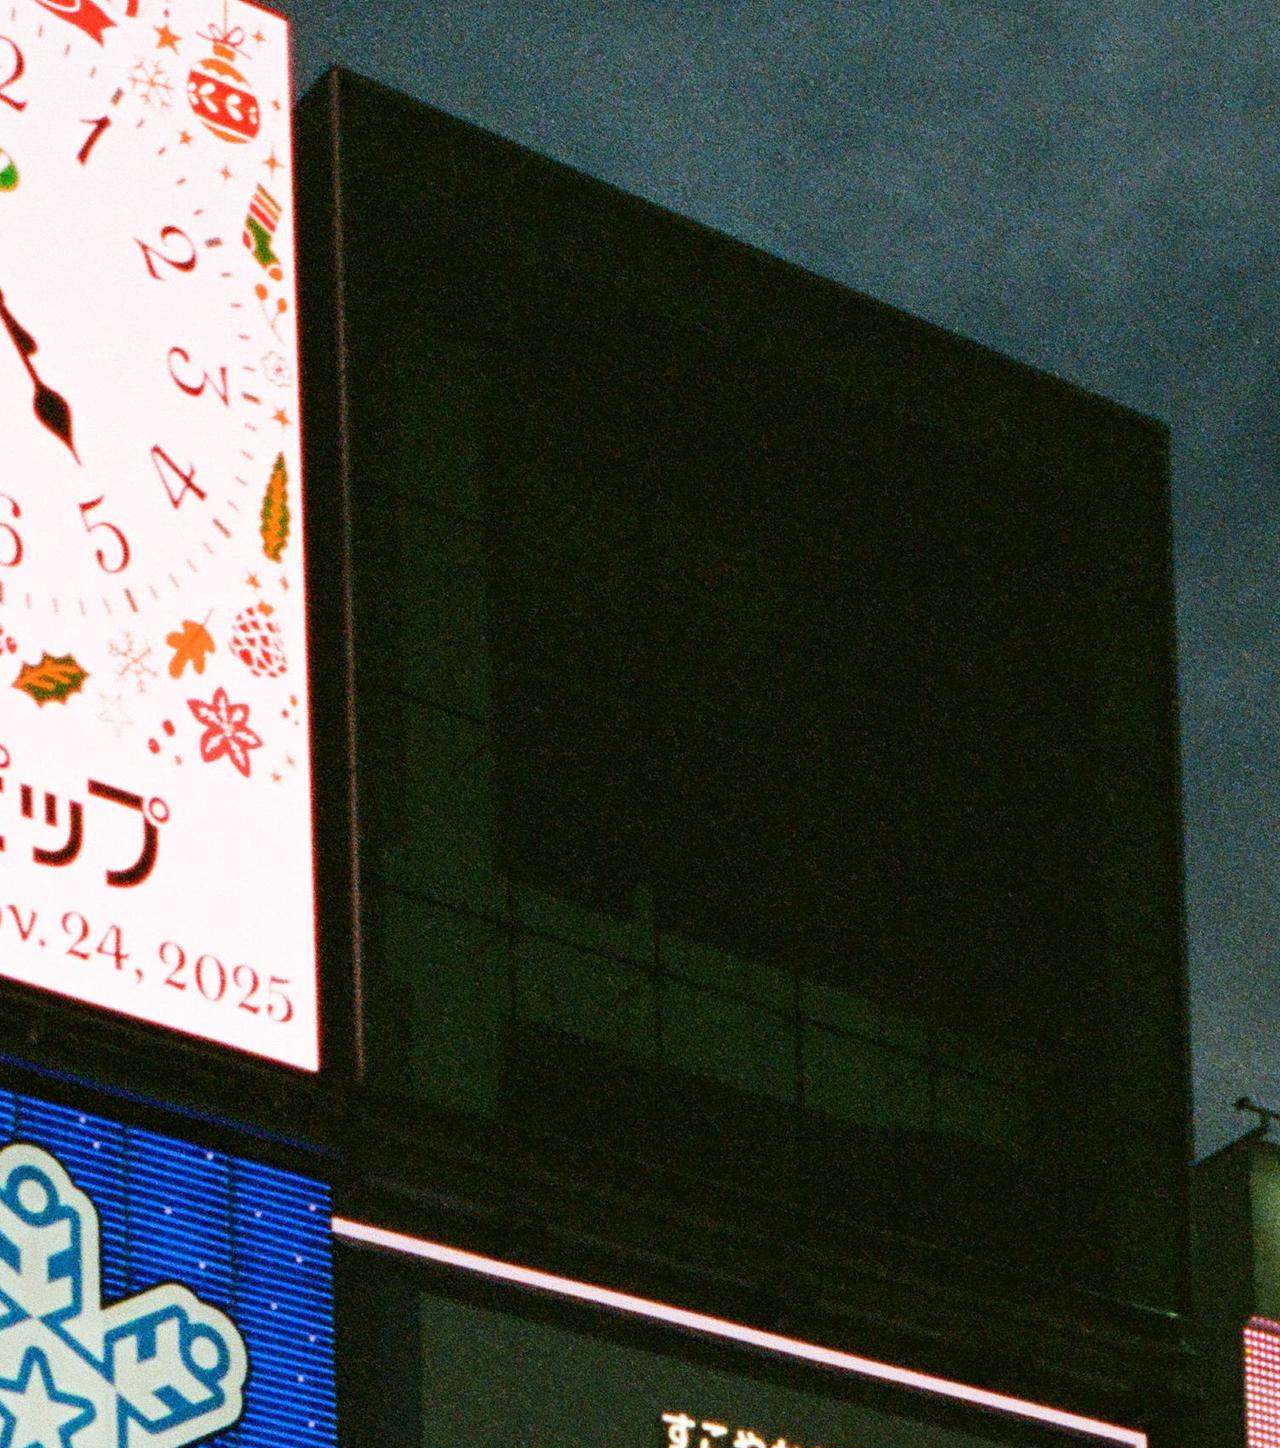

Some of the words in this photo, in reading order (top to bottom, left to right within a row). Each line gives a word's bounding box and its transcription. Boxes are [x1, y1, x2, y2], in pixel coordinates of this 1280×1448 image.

[77, 114, 112, 165] 1
[134, 225, 198, 280] 2
[166, 345, 230, 407] 3
[150, 445, 207, 509] 4
[78, 495, 131, 573] 5
[60, 911, 144, 984] 24,
[158, 940, 296, 1024] 2025
